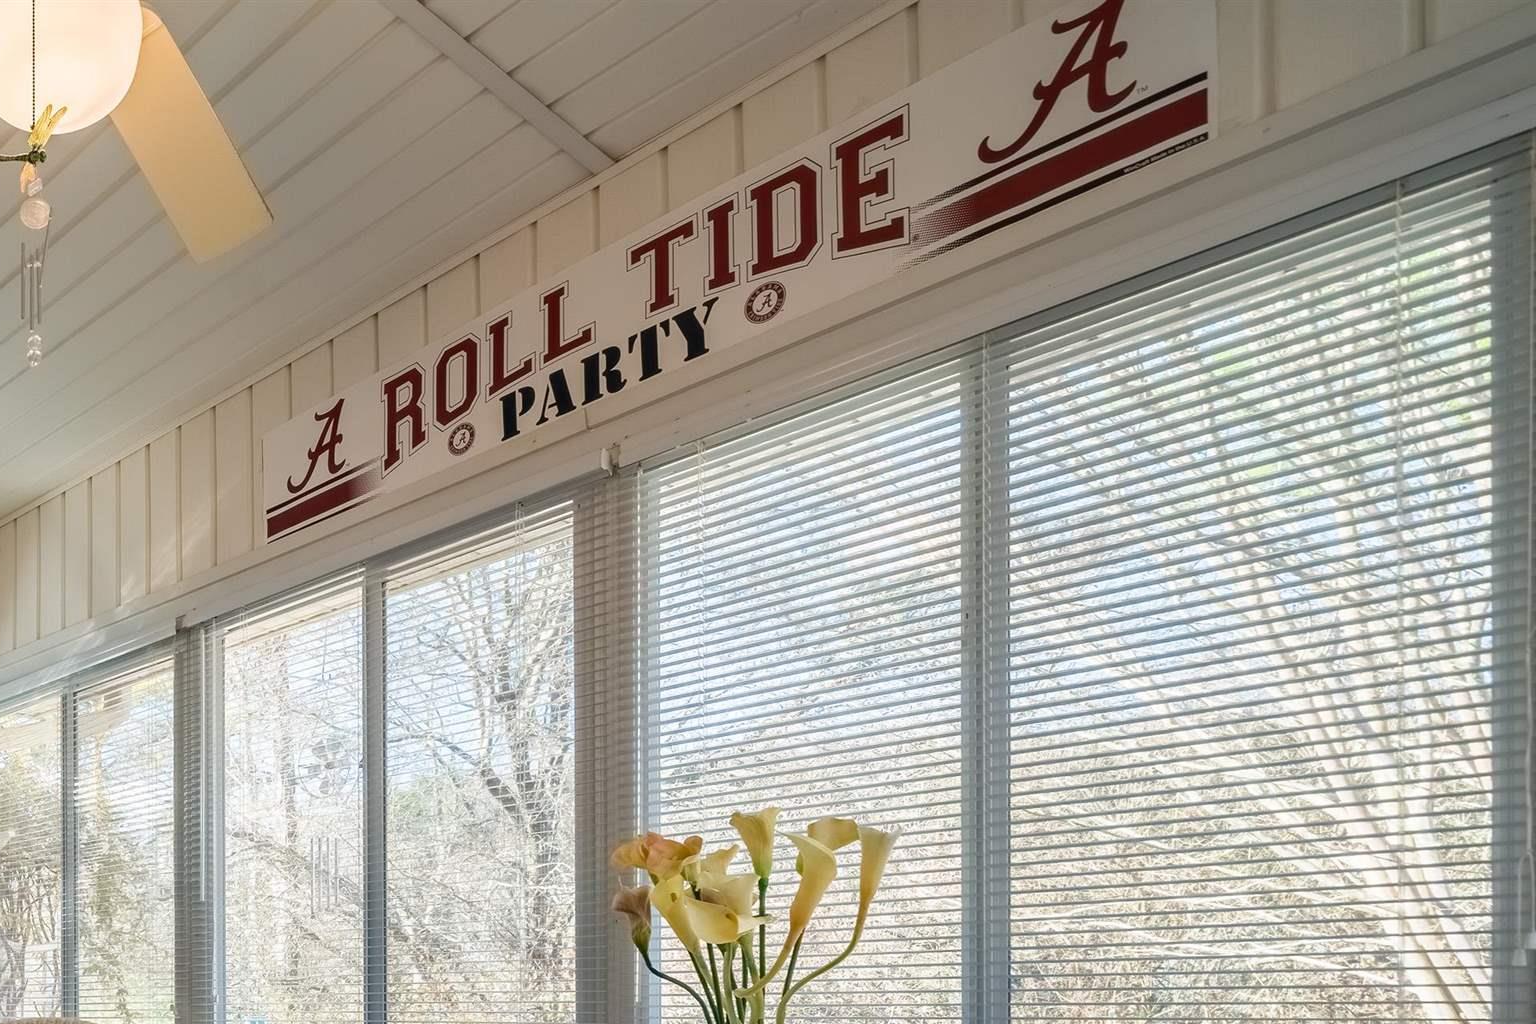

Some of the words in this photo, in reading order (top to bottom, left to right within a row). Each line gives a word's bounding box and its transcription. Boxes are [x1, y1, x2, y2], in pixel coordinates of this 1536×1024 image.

[977, 0, 1137, 164] A
[381, 280, 596, 479] ROLL
[626, 103, 910, 319] TIDE
[287, 398, 346, 494] A
[500, 297, 719, 442] PARTY
